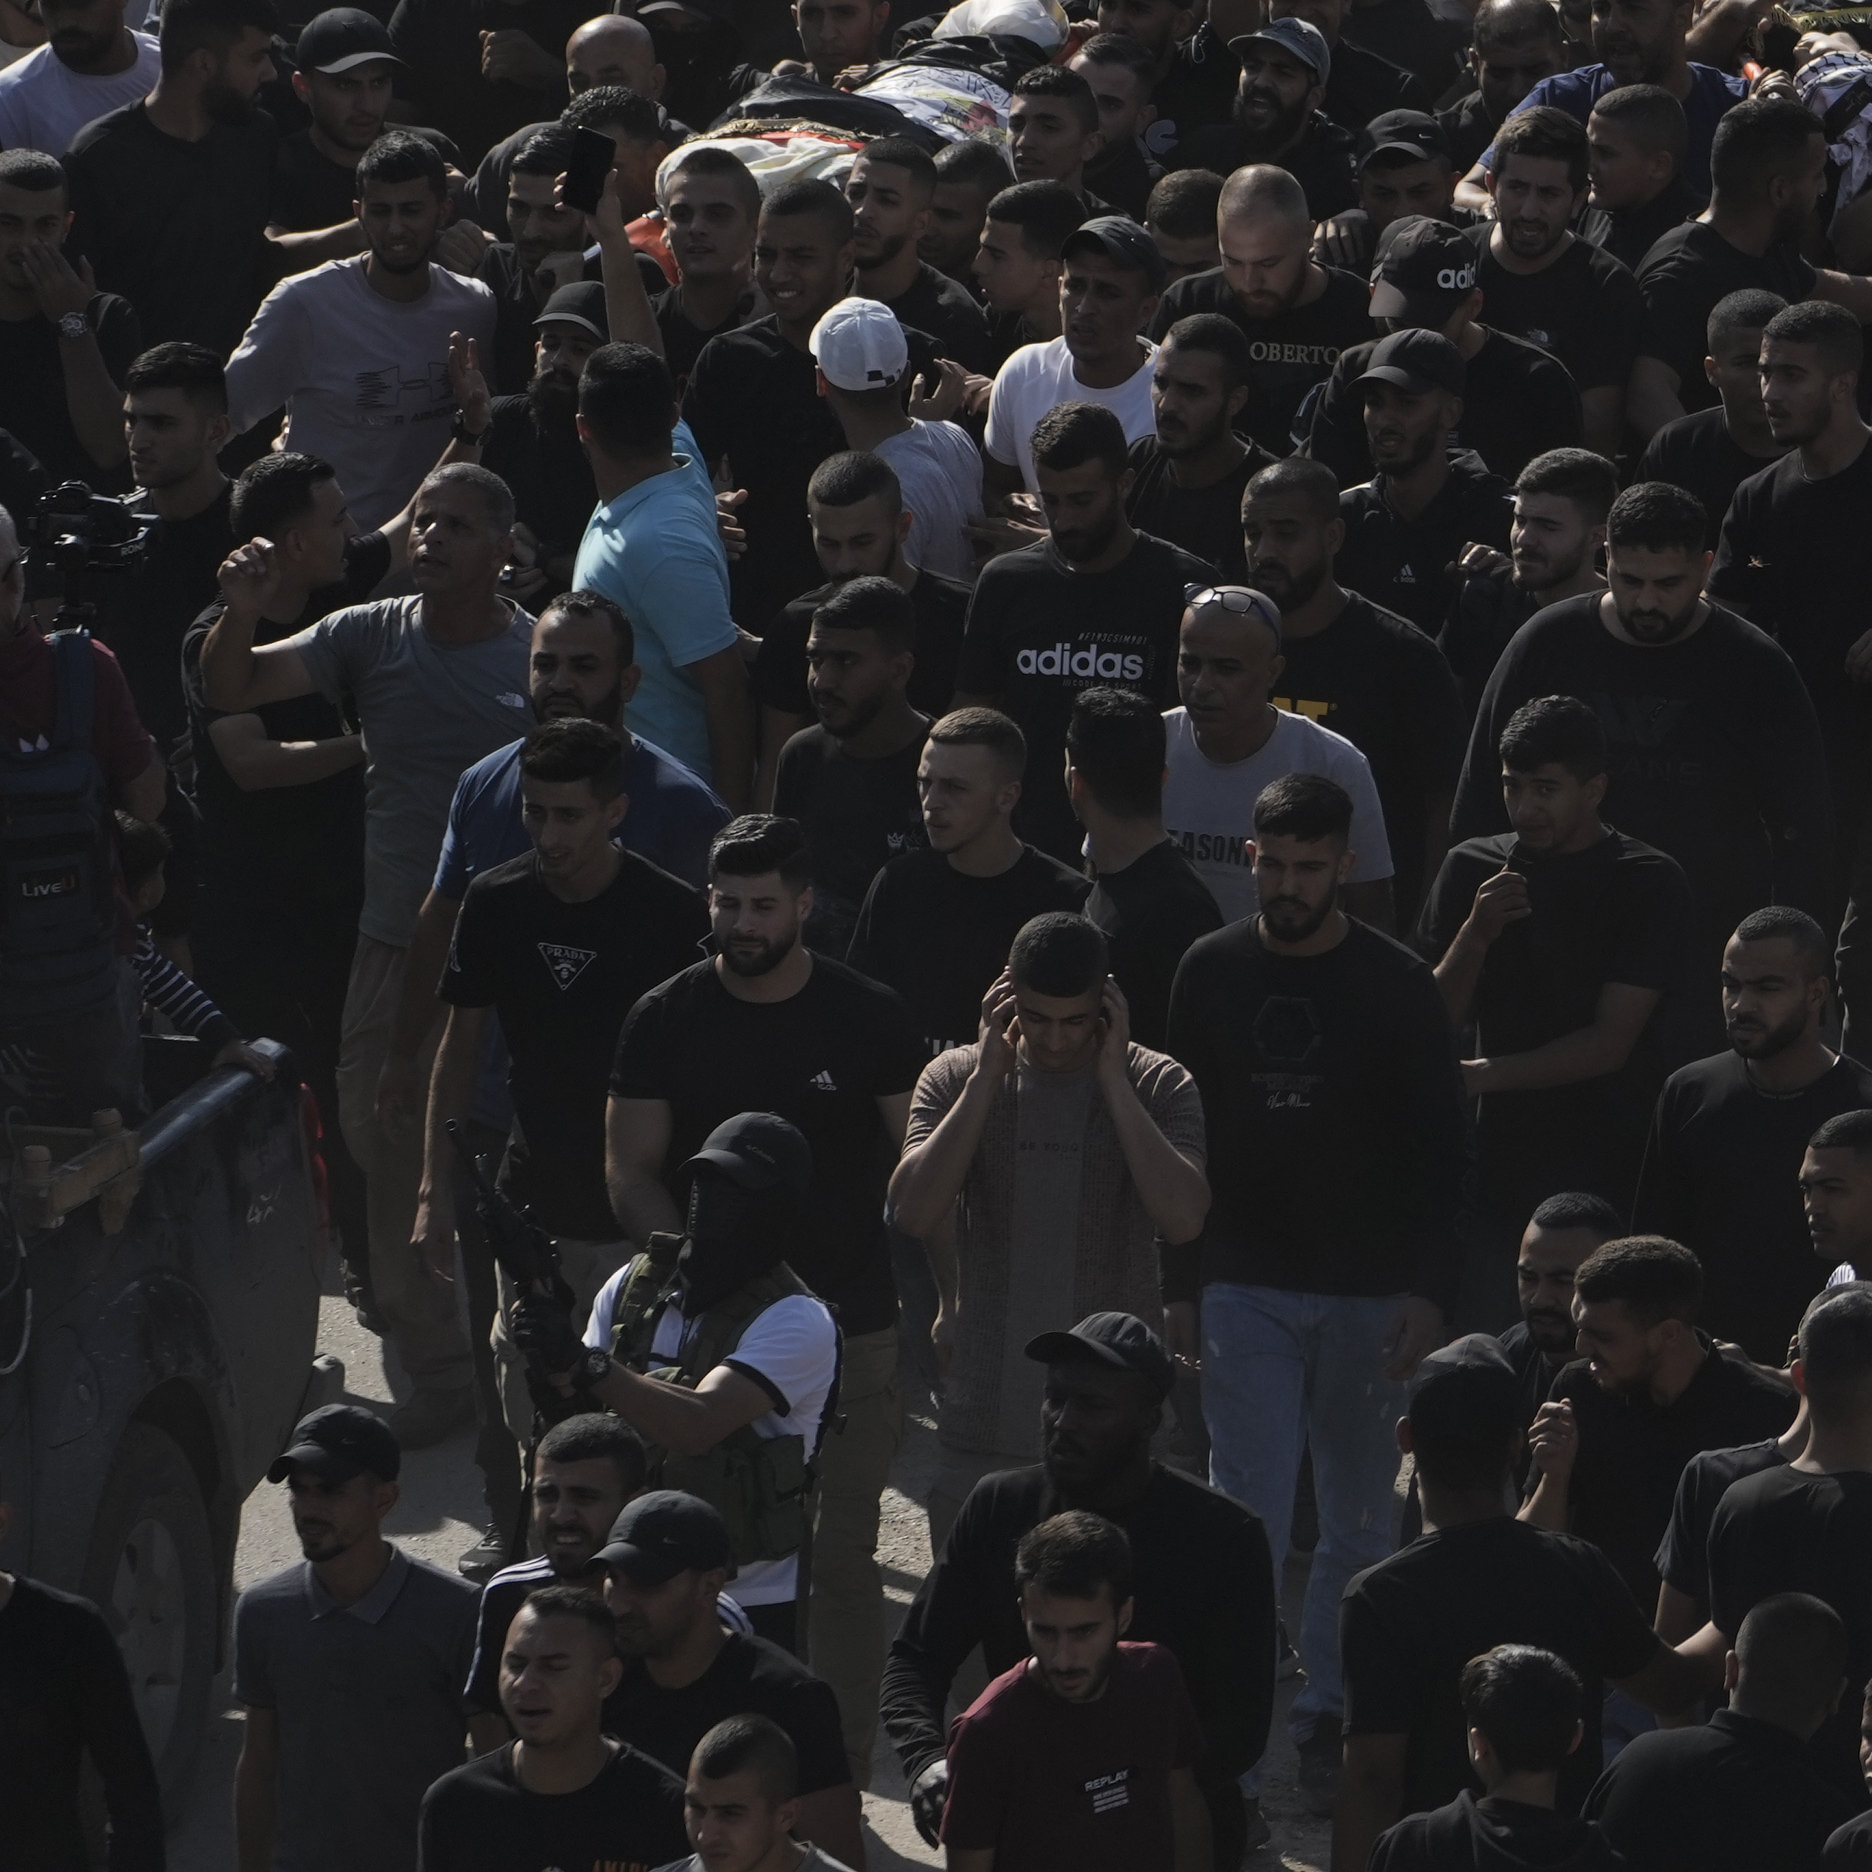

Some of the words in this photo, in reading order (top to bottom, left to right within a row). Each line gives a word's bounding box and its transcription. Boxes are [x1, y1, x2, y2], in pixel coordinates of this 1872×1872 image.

[1016, 642, 1144, 681] adidas
[546, 946, 586, 963] PRADA
[1085, 1769, 1129, 1793] REPLAY
